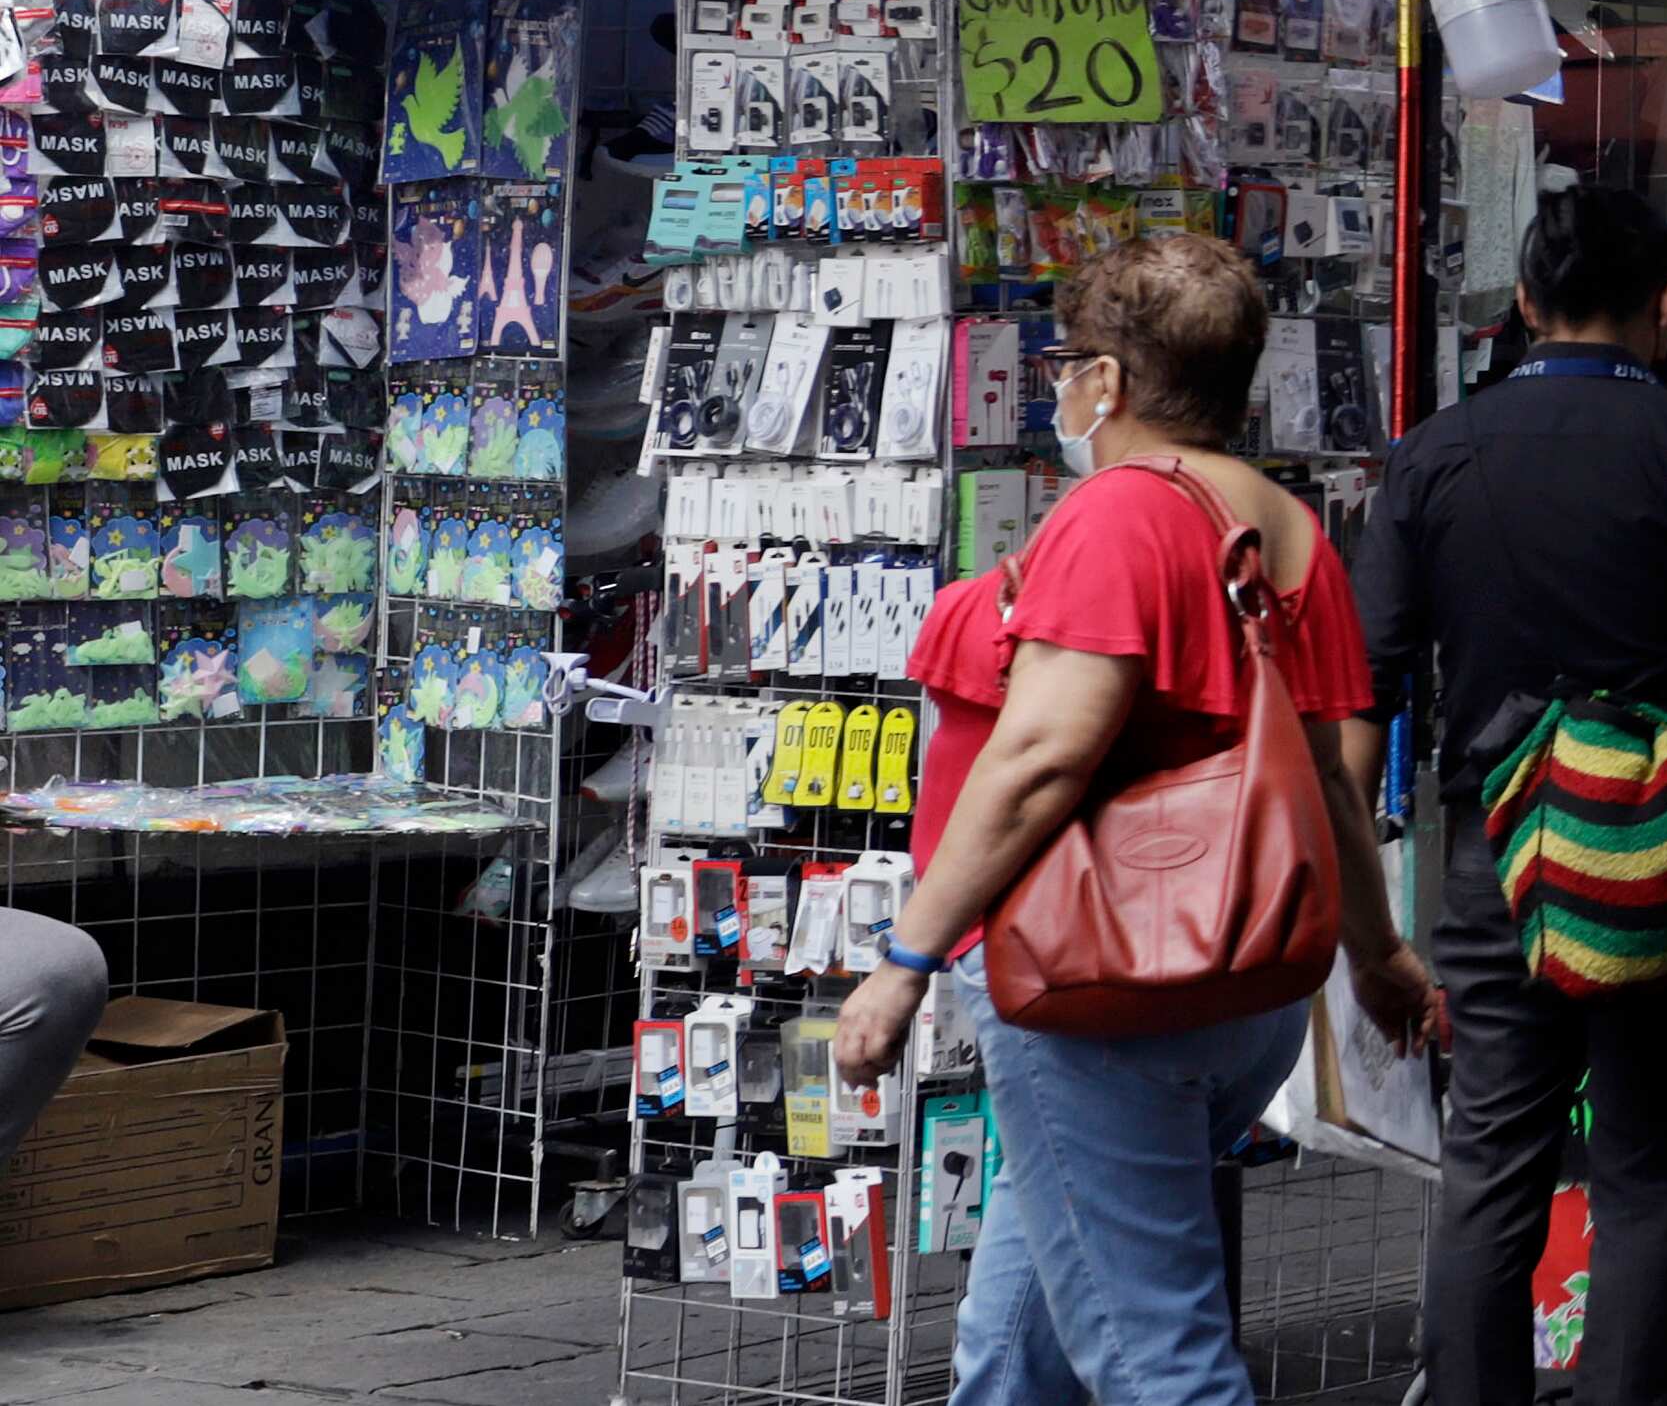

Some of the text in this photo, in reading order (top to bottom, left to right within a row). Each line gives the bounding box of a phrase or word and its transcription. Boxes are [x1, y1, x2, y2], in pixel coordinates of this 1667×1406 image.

[56, 14, 96, 31] ASK
[110, 13, 166, 31] MASK
[100, 65, 149, 88] MASK
[162, 69, 215, 91] MASK
[234, 74, 287, 90] MASK
[973, 36, 1143, 116] $20
[41, 135, 98, 153] MASK
[173, 137, 211, 154] MAS
[281, 139, 319, 156] MAS
[220, 143, 267, 164] MASK
[119, 201, 158, 217] ASK
[230, 203, 277, 219] MASK
[288, 203, 340, 219] MASK
[49, 262, 108, 284] MASK
[123, 265, 165, 282] ASK
[295, 264, 348, 285] MASK
[37, 326, 92, 343] MASK
[167, 451, 224, 472] MASK
[235, 446, 272, 463] ASK
[283, 449, 319, 466] MAS
[330, 449, 375, 469] MASK
[784, 725, 803, 746] OT
[809, 725, 835, 748] OTG
[849, 729, 872, 751] OTG
[885, 732, 908, 754] OTG
